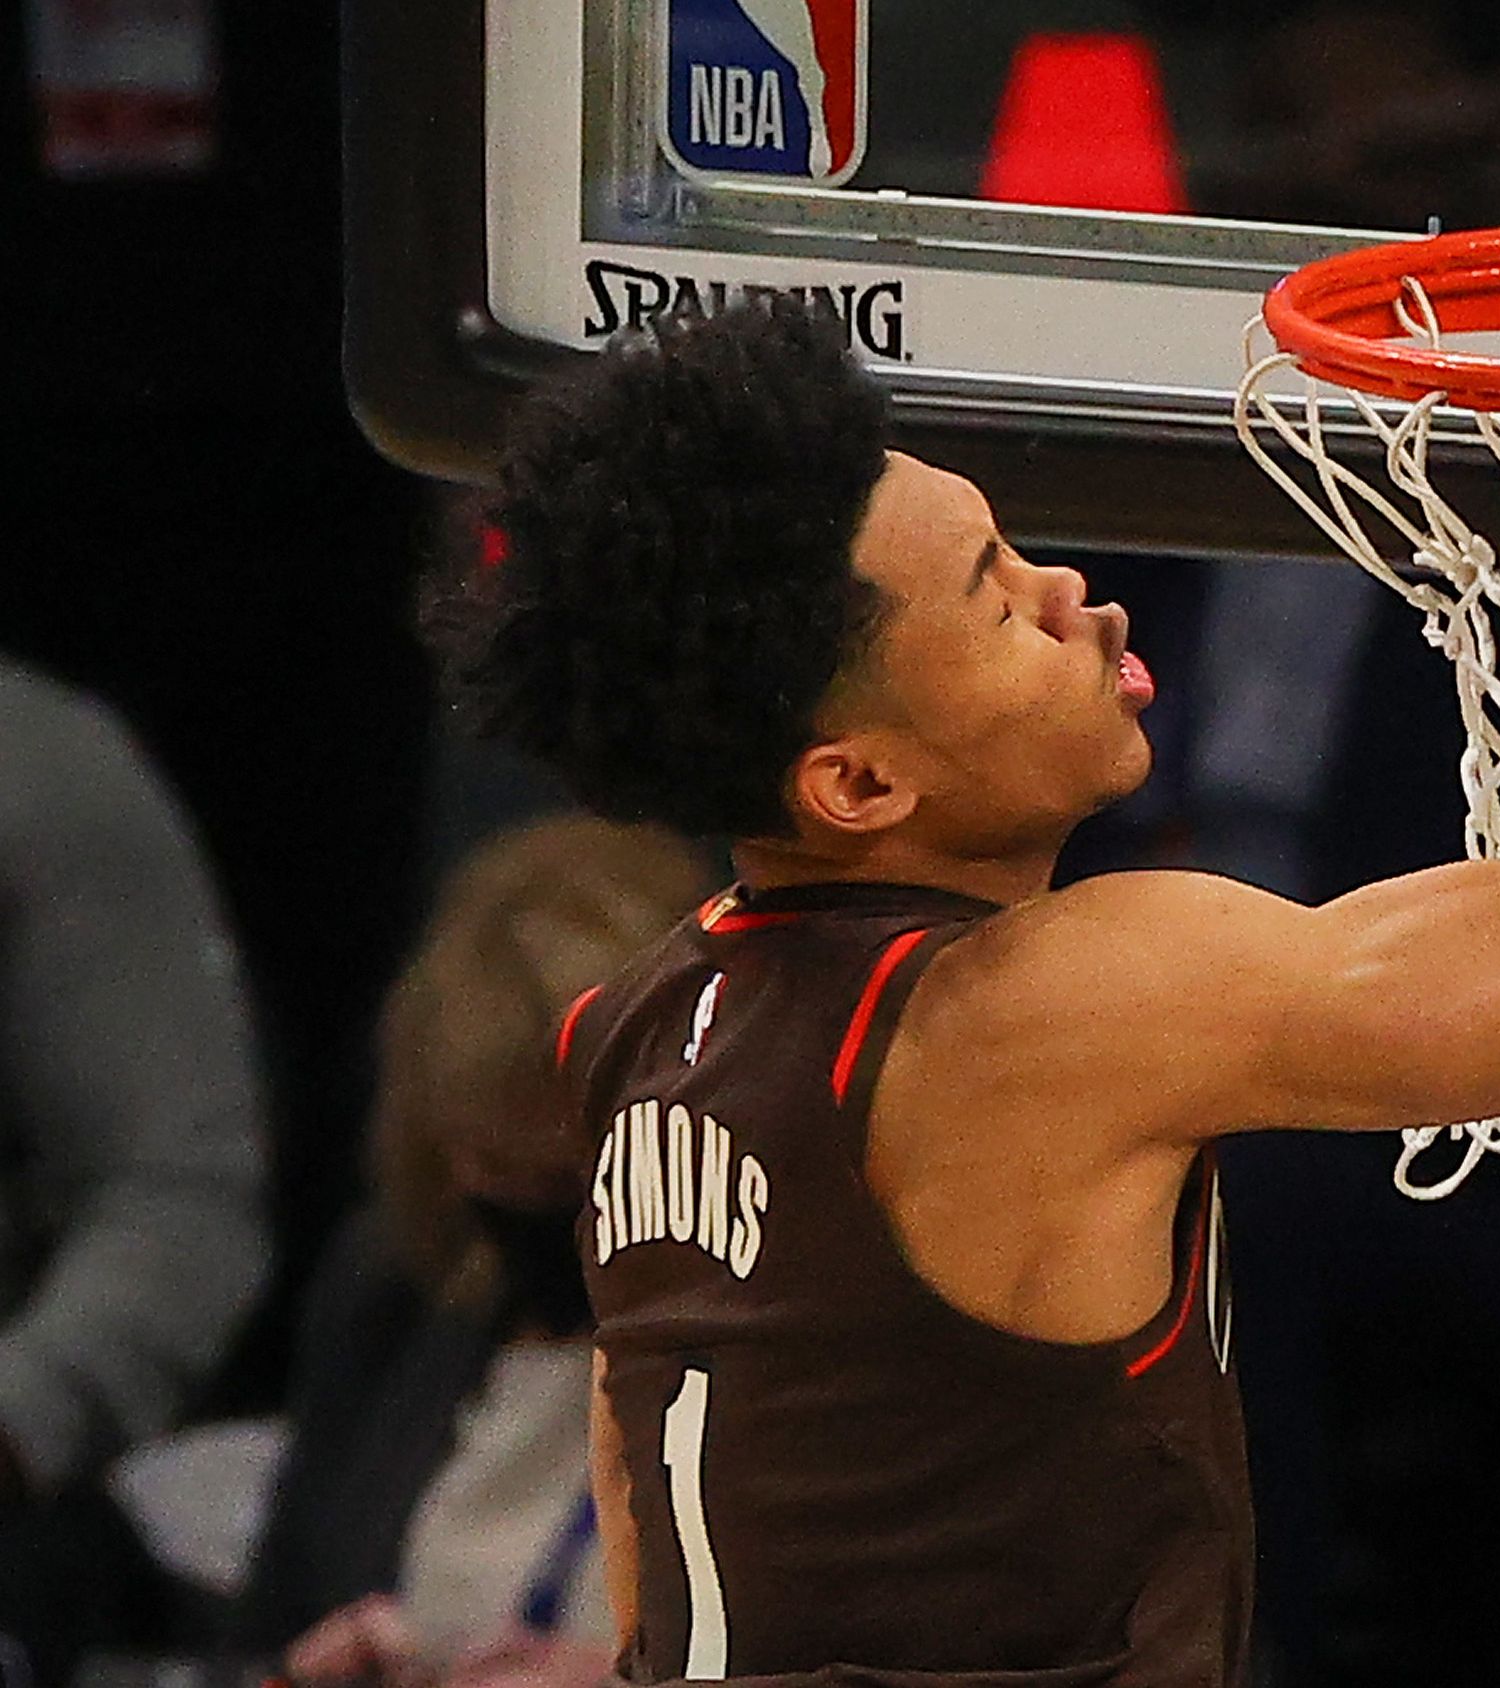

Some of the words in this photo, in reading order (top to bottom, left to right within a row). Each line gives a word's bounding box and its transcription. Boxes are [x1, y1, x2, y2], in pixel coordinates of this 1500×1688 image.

[690, 63, 785, 151] NBA
[591, 1098, 770, 1281] SIMONS
[662, 1368, 728, 1681] 1
